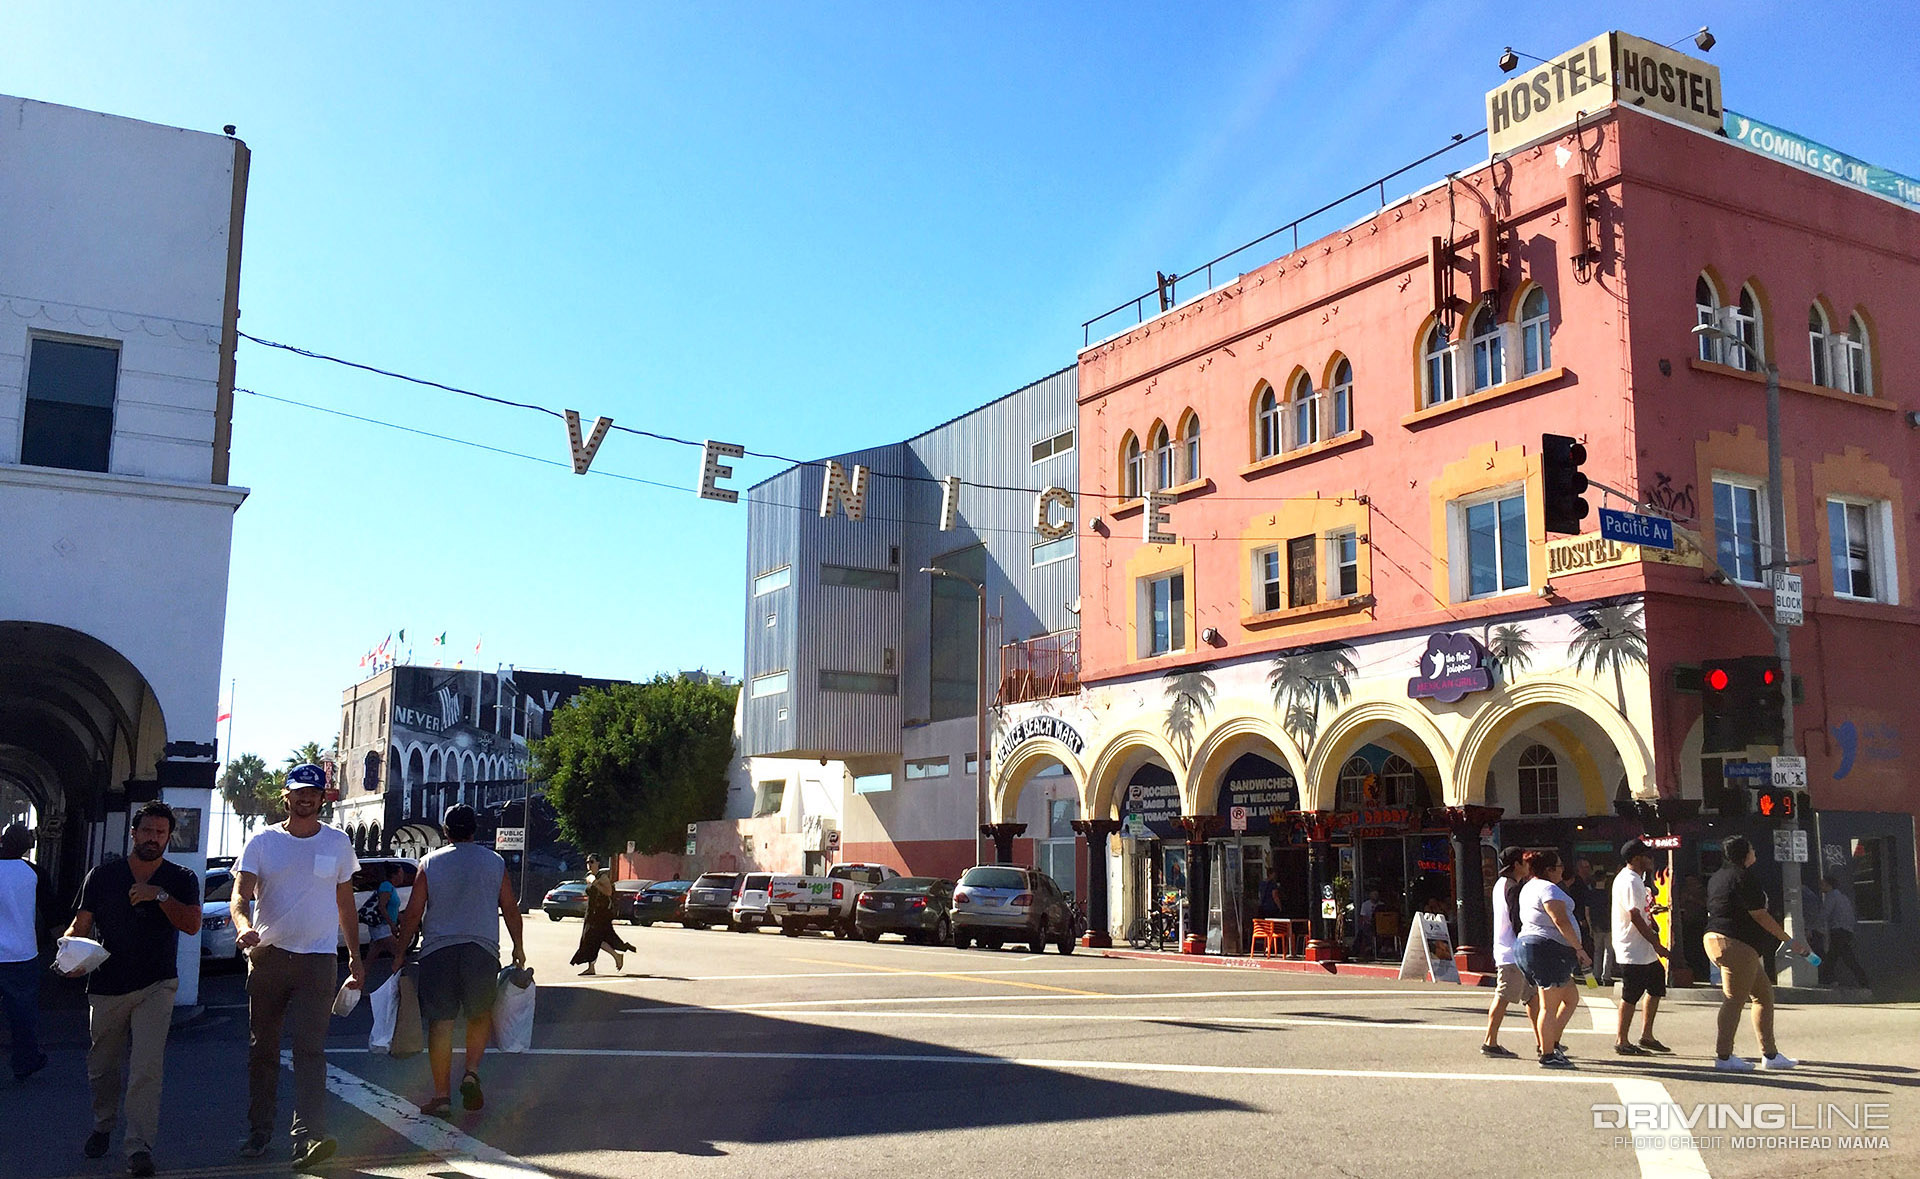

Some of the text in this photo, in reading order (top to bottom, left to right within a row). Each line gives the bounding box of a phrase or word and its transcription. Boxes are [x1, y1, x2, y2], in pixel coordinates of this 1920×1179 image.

[1492, 46, 1606, 134] HOSTEL
[1623, 49, 1720, 119] HOSTEL
[1750, 127, 1819, 168] COMING
[1822, 154, 1868, 187] SOON
[565, 409, 1177, 545] VENICE
[1605, 515, 1650, 537] Pacific
[1653, 523, 1668, 540] Av
[1549, 540, 1622, 573] HOSTEL
[1788, 581, 1801, 593] NOT
[1776, 596, 1801, 609] BLOCK
[1417, 677, 1478, 691] MEXICAN GRILL
[394, 704, 440, 732] NEVER
[997, 717, 1082, 766] VENICE BEACH MART
[1230, 777, 1293, 792] SANDWICHES
[1774, 772, 1788, 784] OK
[1249, 792, 1290, 803] WELCOME
[1246, 806, 1257, 817] ELI
